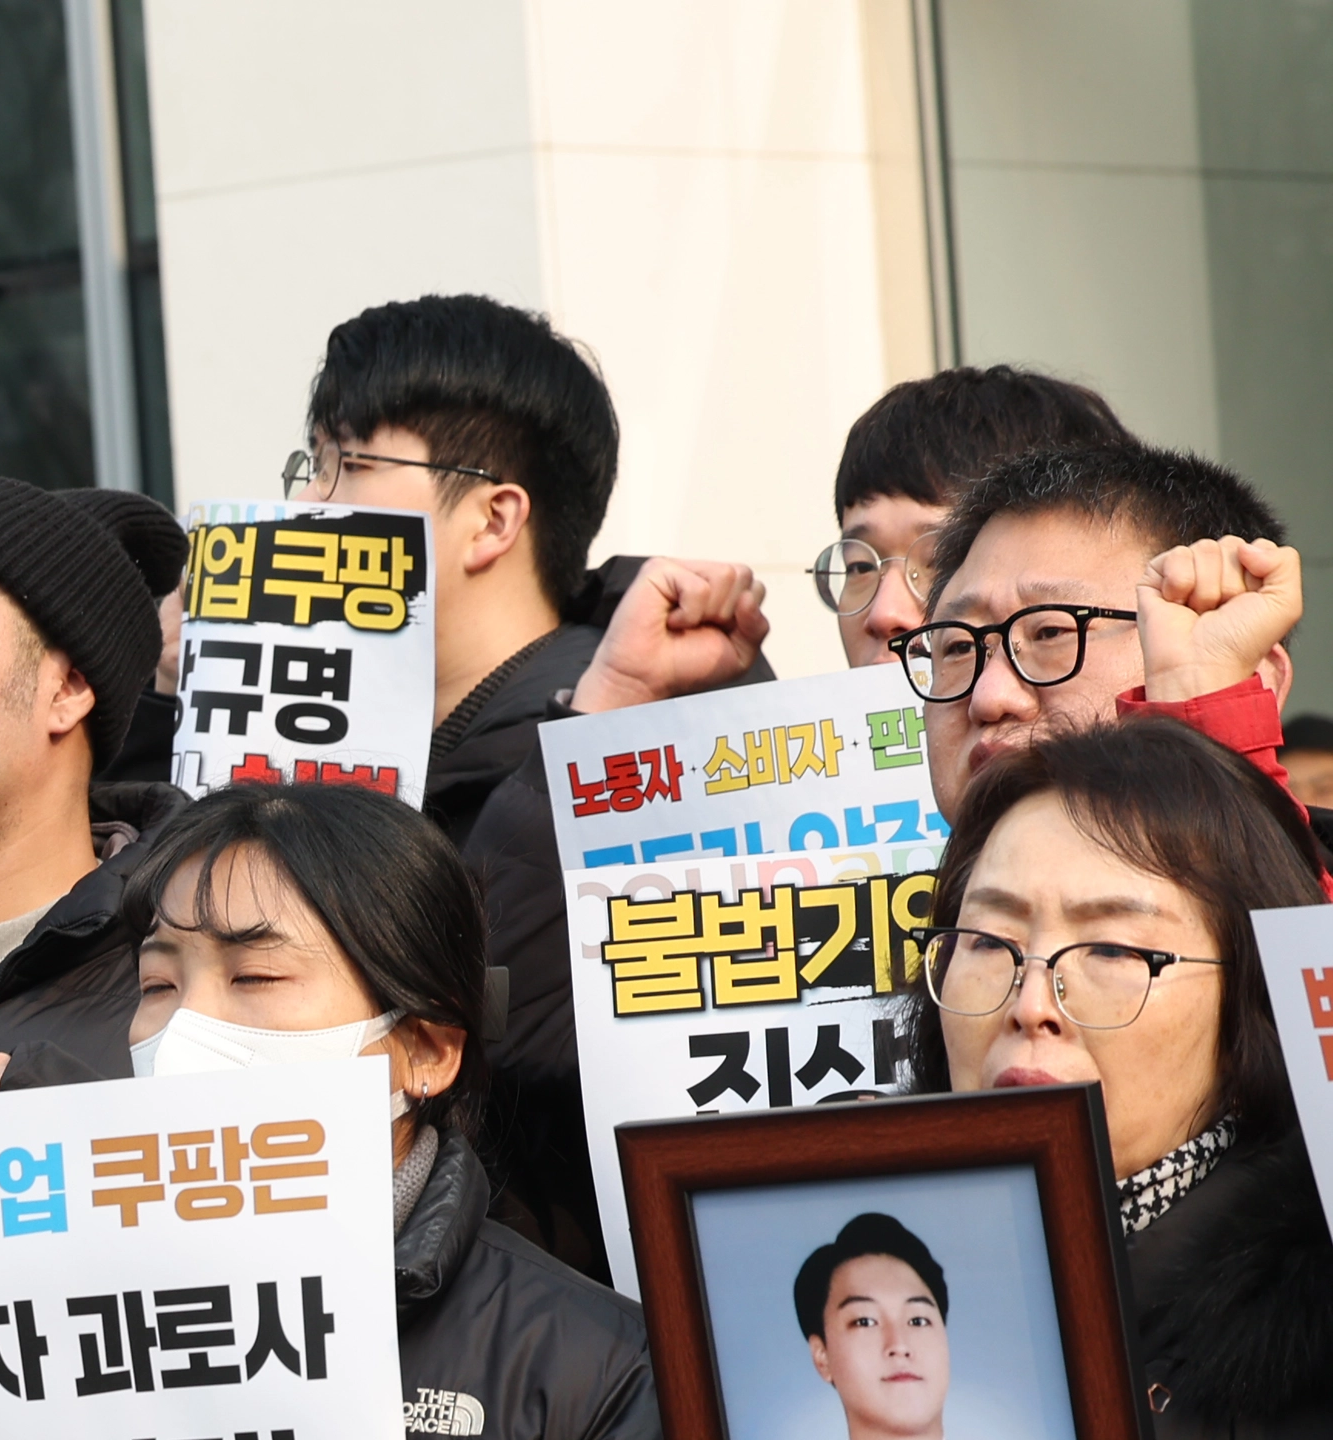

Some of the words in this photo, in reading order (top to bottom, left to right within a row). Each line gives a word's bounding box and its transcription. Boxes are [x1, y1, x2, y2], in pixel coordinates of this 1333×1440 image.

[263, 529, 414, 631] 쿠팡
[176, 639, 353, 745] 규명
[566, 744, 685, 819] 노동자
[702, 717, 845, 796] 소비자
[89, 1118, 329, 1228] 쿠팡은
[66, 1275, 336, 1398] 과로사
[403, 1401, 453, 1421] ORTH
[416, 1387, 456, 1407] THE
